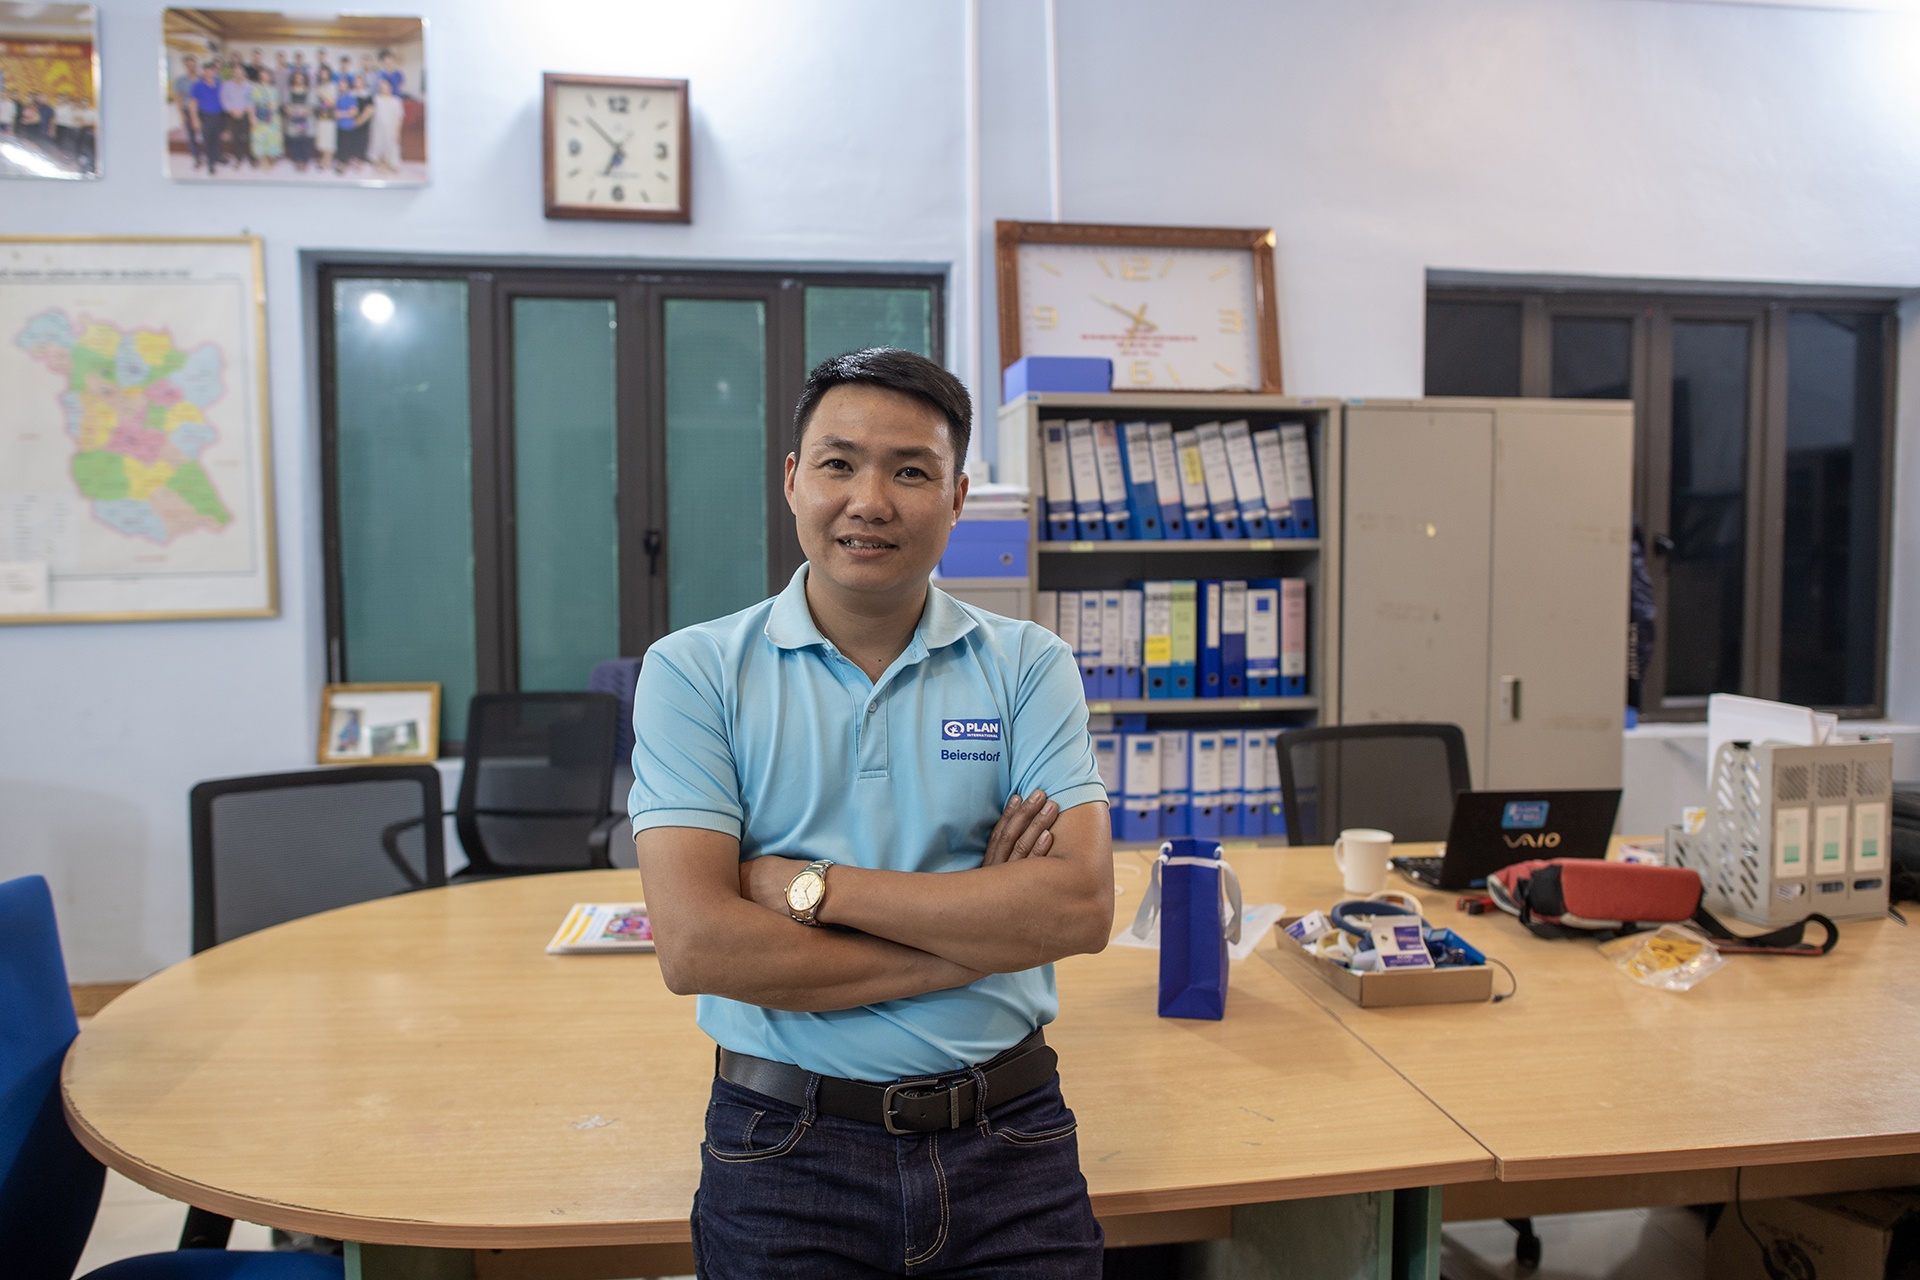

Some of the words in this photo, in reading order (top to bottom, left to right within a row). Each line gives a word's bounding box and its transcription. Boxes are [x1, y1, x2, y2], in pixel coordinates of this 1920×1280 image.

[607, 96, 628, 114] 12
[611, 185, 624, 202] 6
[1121, 256, 1151, 281] 12
[1033, 305, 1058, 330] 9
[1217, 308, 1243, 335] 3
[1129, 360, 1154, 386] 6
[966, 722, 999, 733] PLAN
[941, 749, 1001, 762] Beiersdorf
[1503, 832, 1561, 848] VAIO
